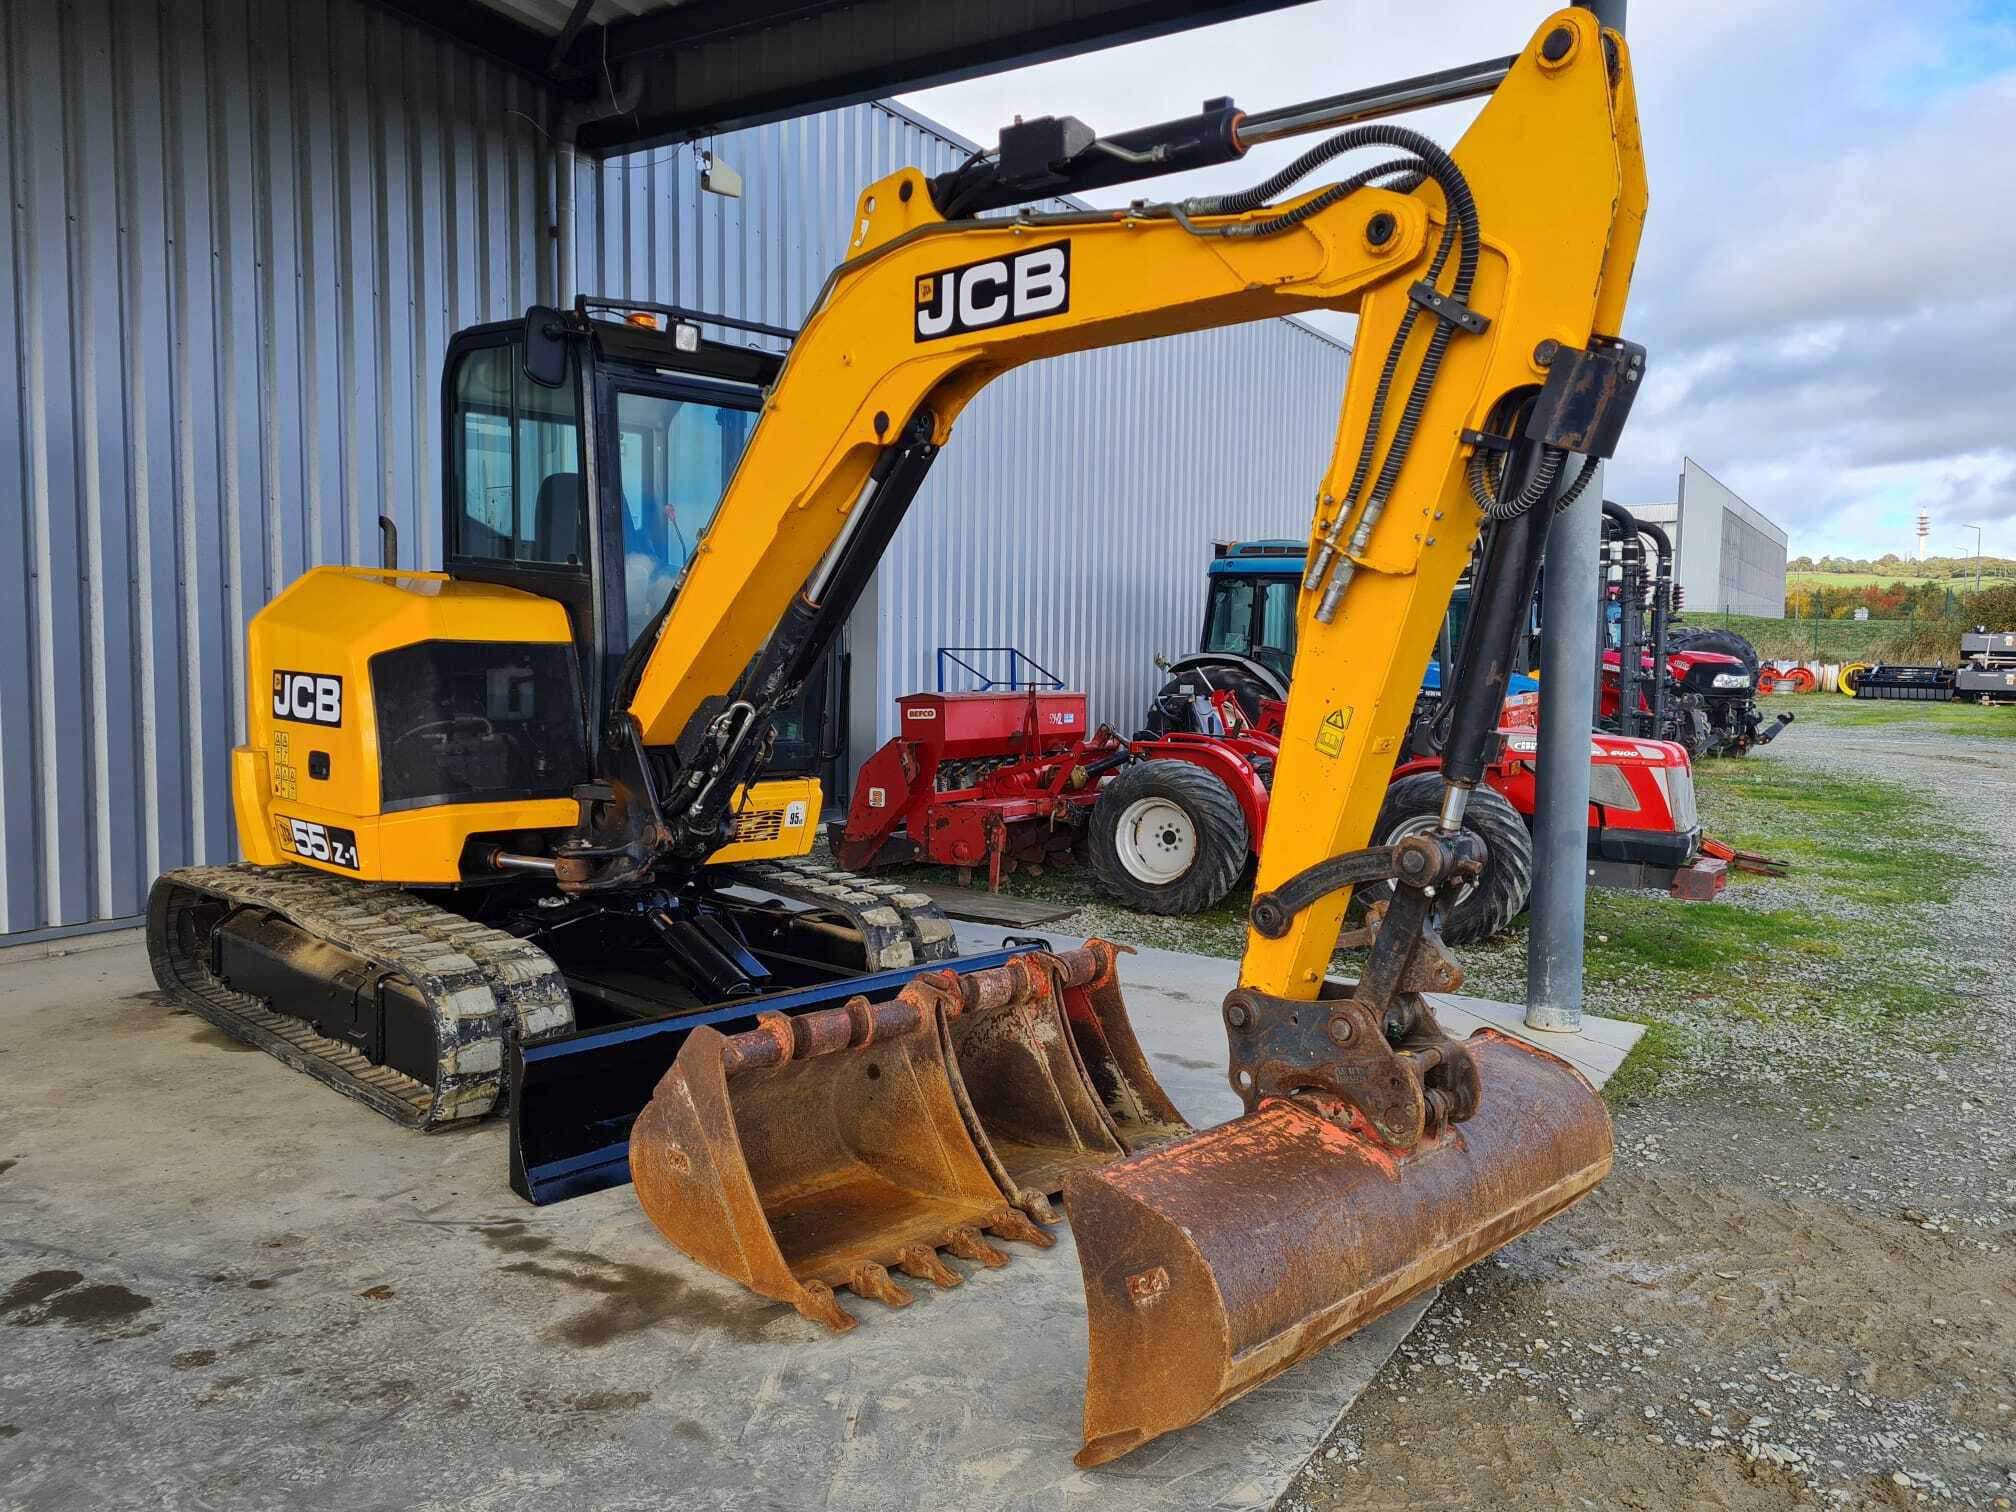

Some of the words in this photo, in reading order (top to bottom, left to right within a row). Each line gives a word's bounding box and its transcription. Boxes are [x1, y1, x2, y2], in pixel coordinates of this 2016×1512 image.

[918, 248, 1066, 335] JCB
[274, 674, 340, 723] JCB
[909, 710, 935, 718] BEFCO
[290, 818, 330, 861] 55
